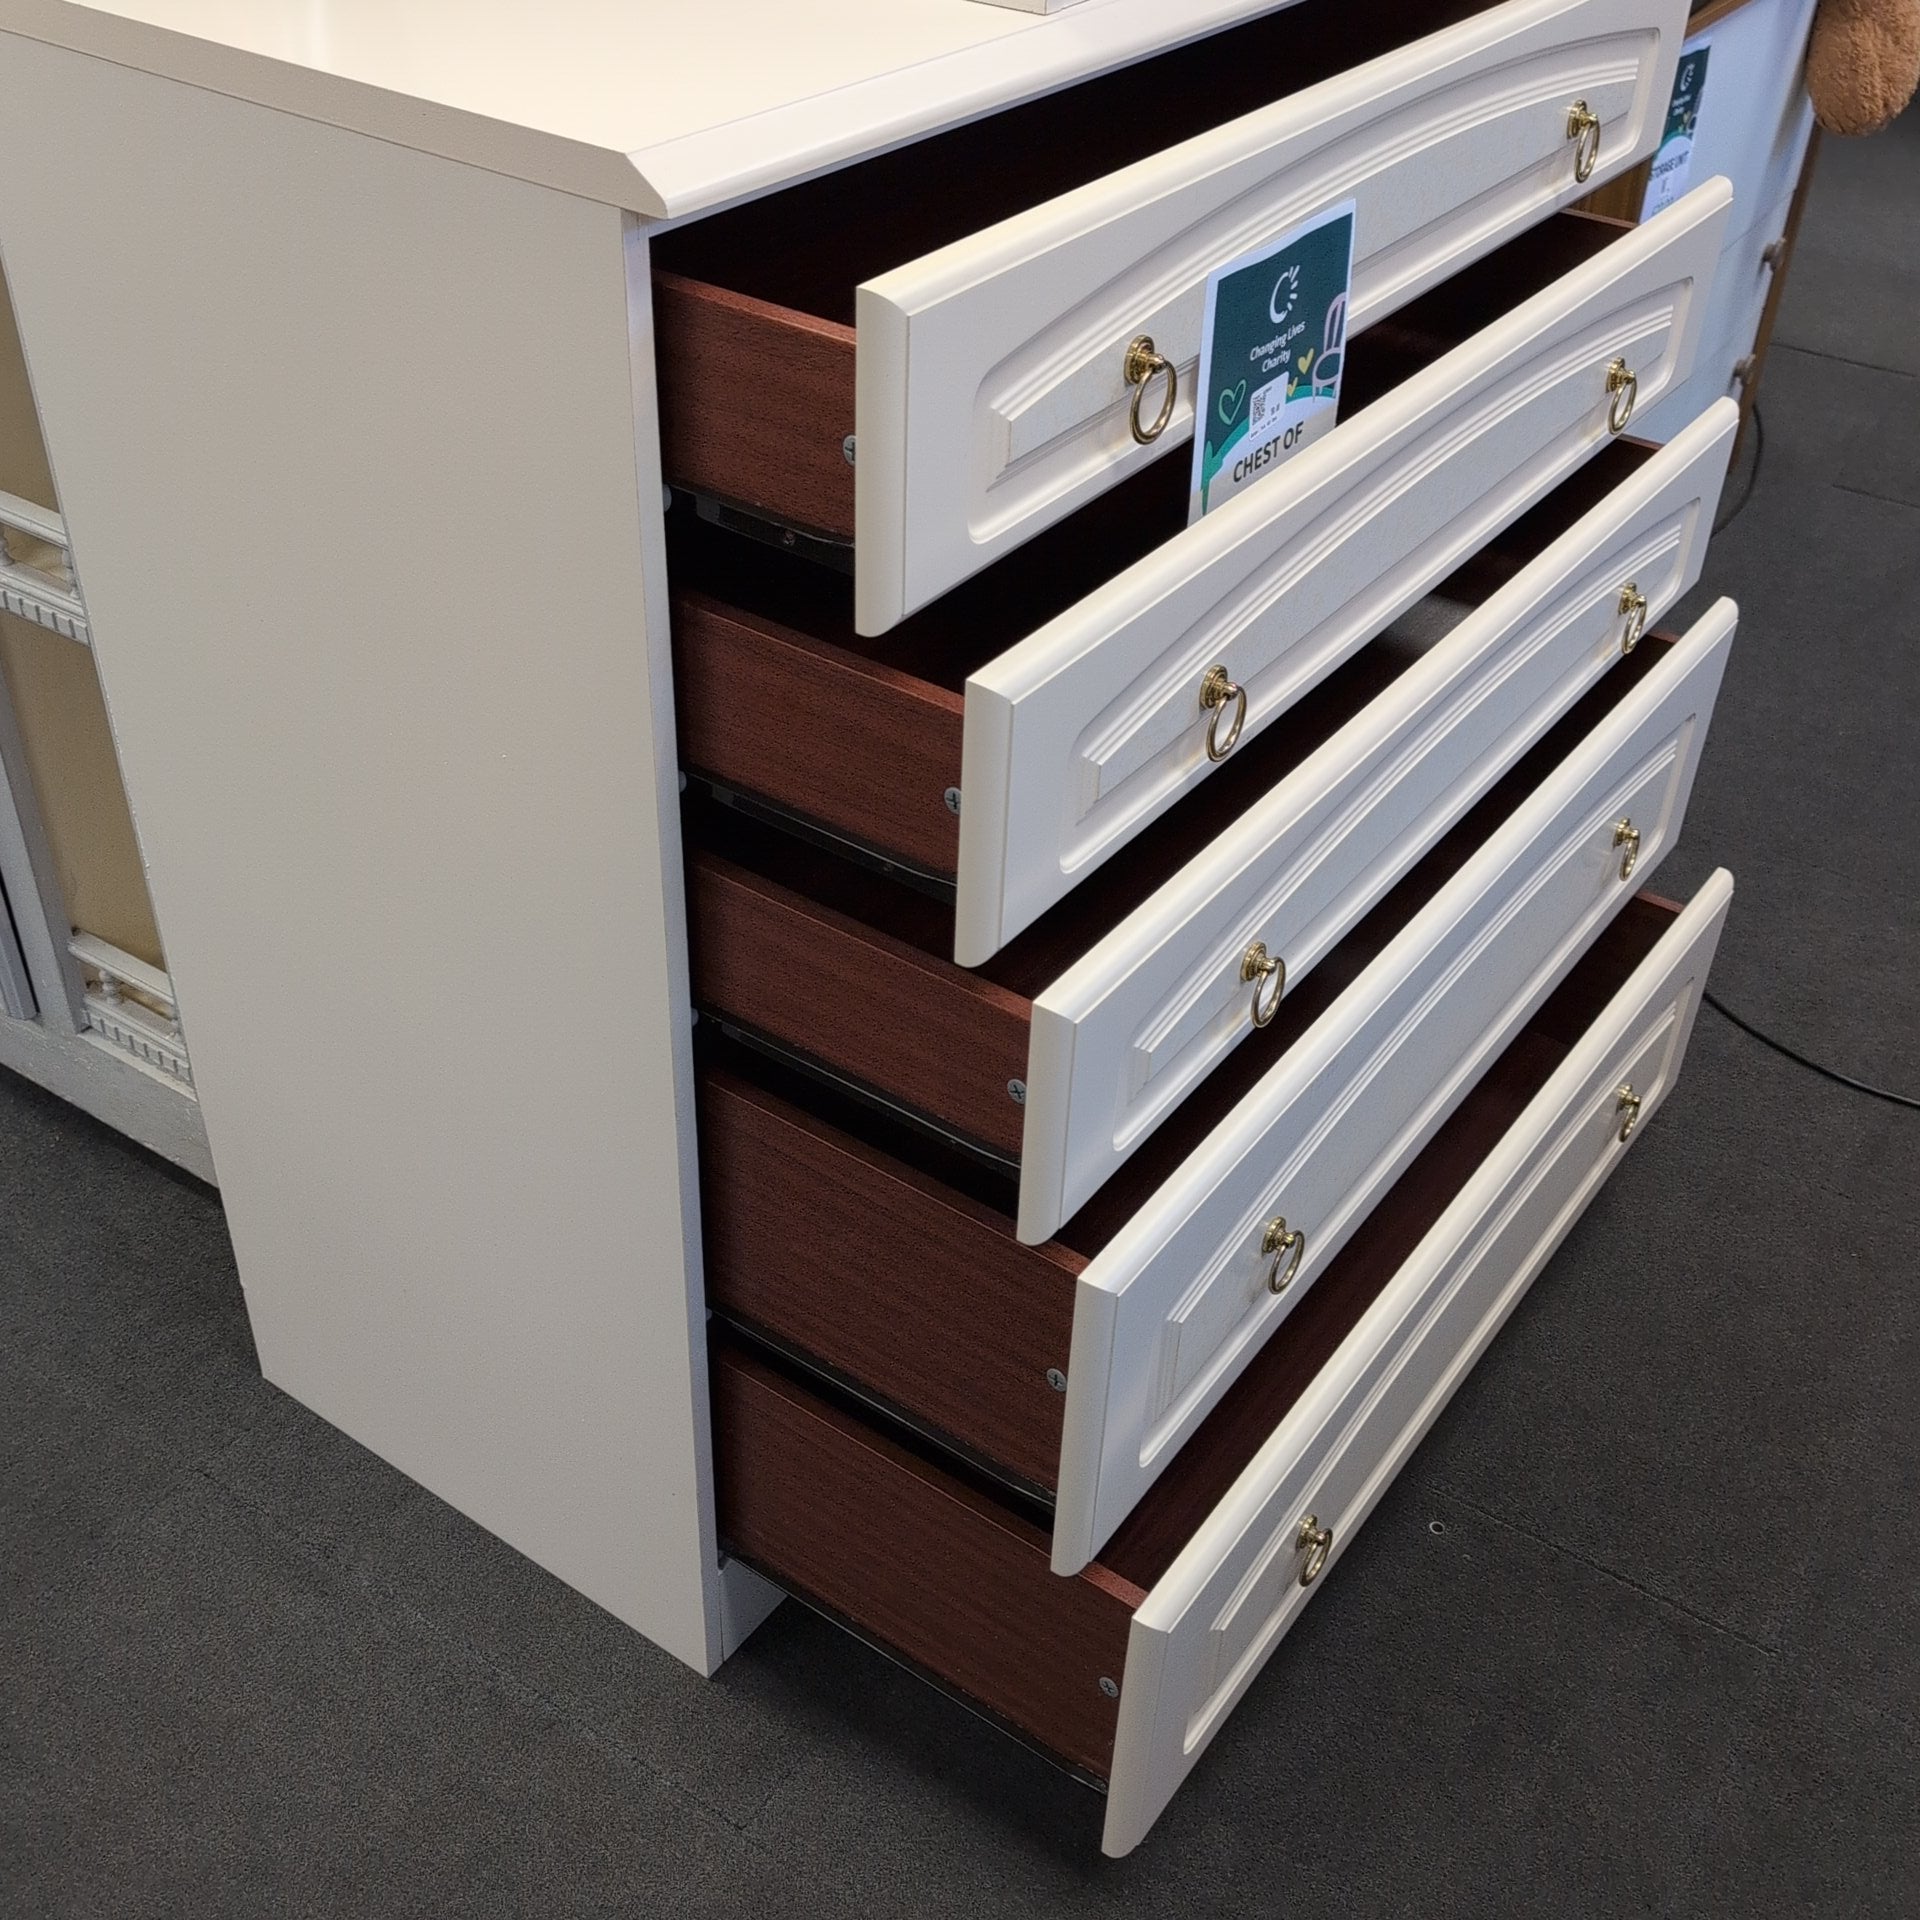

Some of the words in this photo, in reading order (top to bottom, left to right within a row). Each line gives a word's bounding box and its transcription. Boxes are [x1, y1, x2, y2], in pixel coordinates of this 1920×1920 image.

[1250, 330, 1287, 361] Changing
[1287, 321, 1306, 341] Lives
[1262, 349, 1291, 373] Charity
[1233, 435, 1281, 483] CHEST
[1283, 420, 1304, 450] OF
